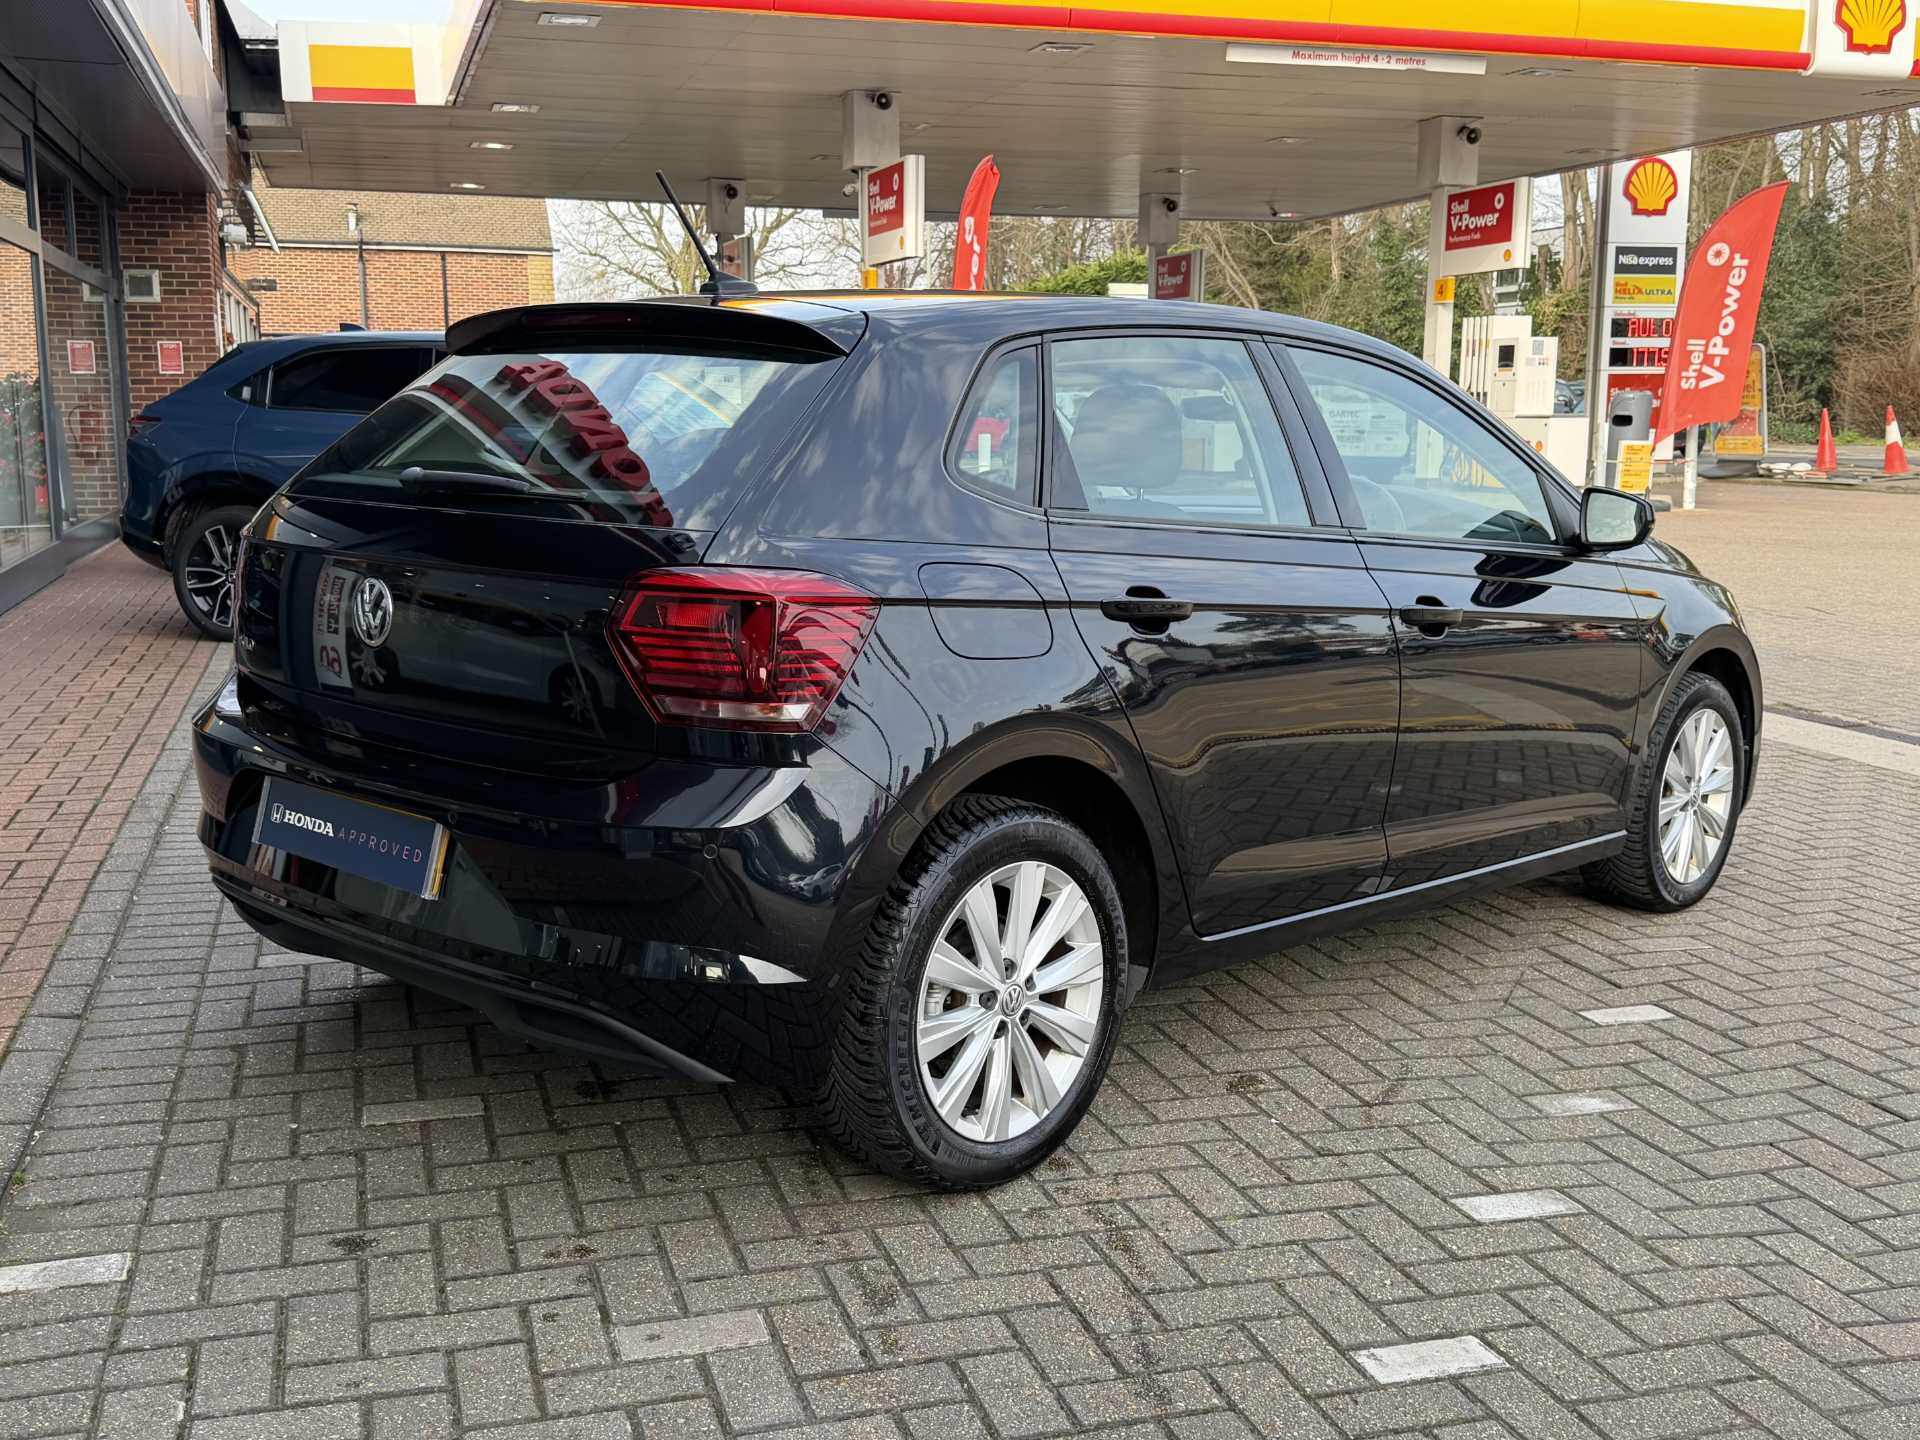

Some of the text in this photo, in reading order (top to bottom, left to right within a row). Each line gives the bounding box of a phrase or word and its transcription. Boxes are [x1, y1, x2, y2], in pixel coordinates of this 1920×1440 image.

[1291, 49, 1338, 61] Maximum
[1341, 51, 1371, 64] height
[1395, 55, 1427, 66] metres
[869, 195, 897, 215] V-Power
[1450, 199, 1469, 214] Shell
[1450, 212, 1500, 232] V-Power
[1618, 254, 1674, 267] Nisa express
[1645, 288, 1673, 296] ULTRA
[1698, 252, 1749, 390] V-Power
[1680, 338, 1706, 390] Shell
[283, 809, 423, 864] HONDA APPROVED
[895, 998, 922, 1121] MICHELIN
